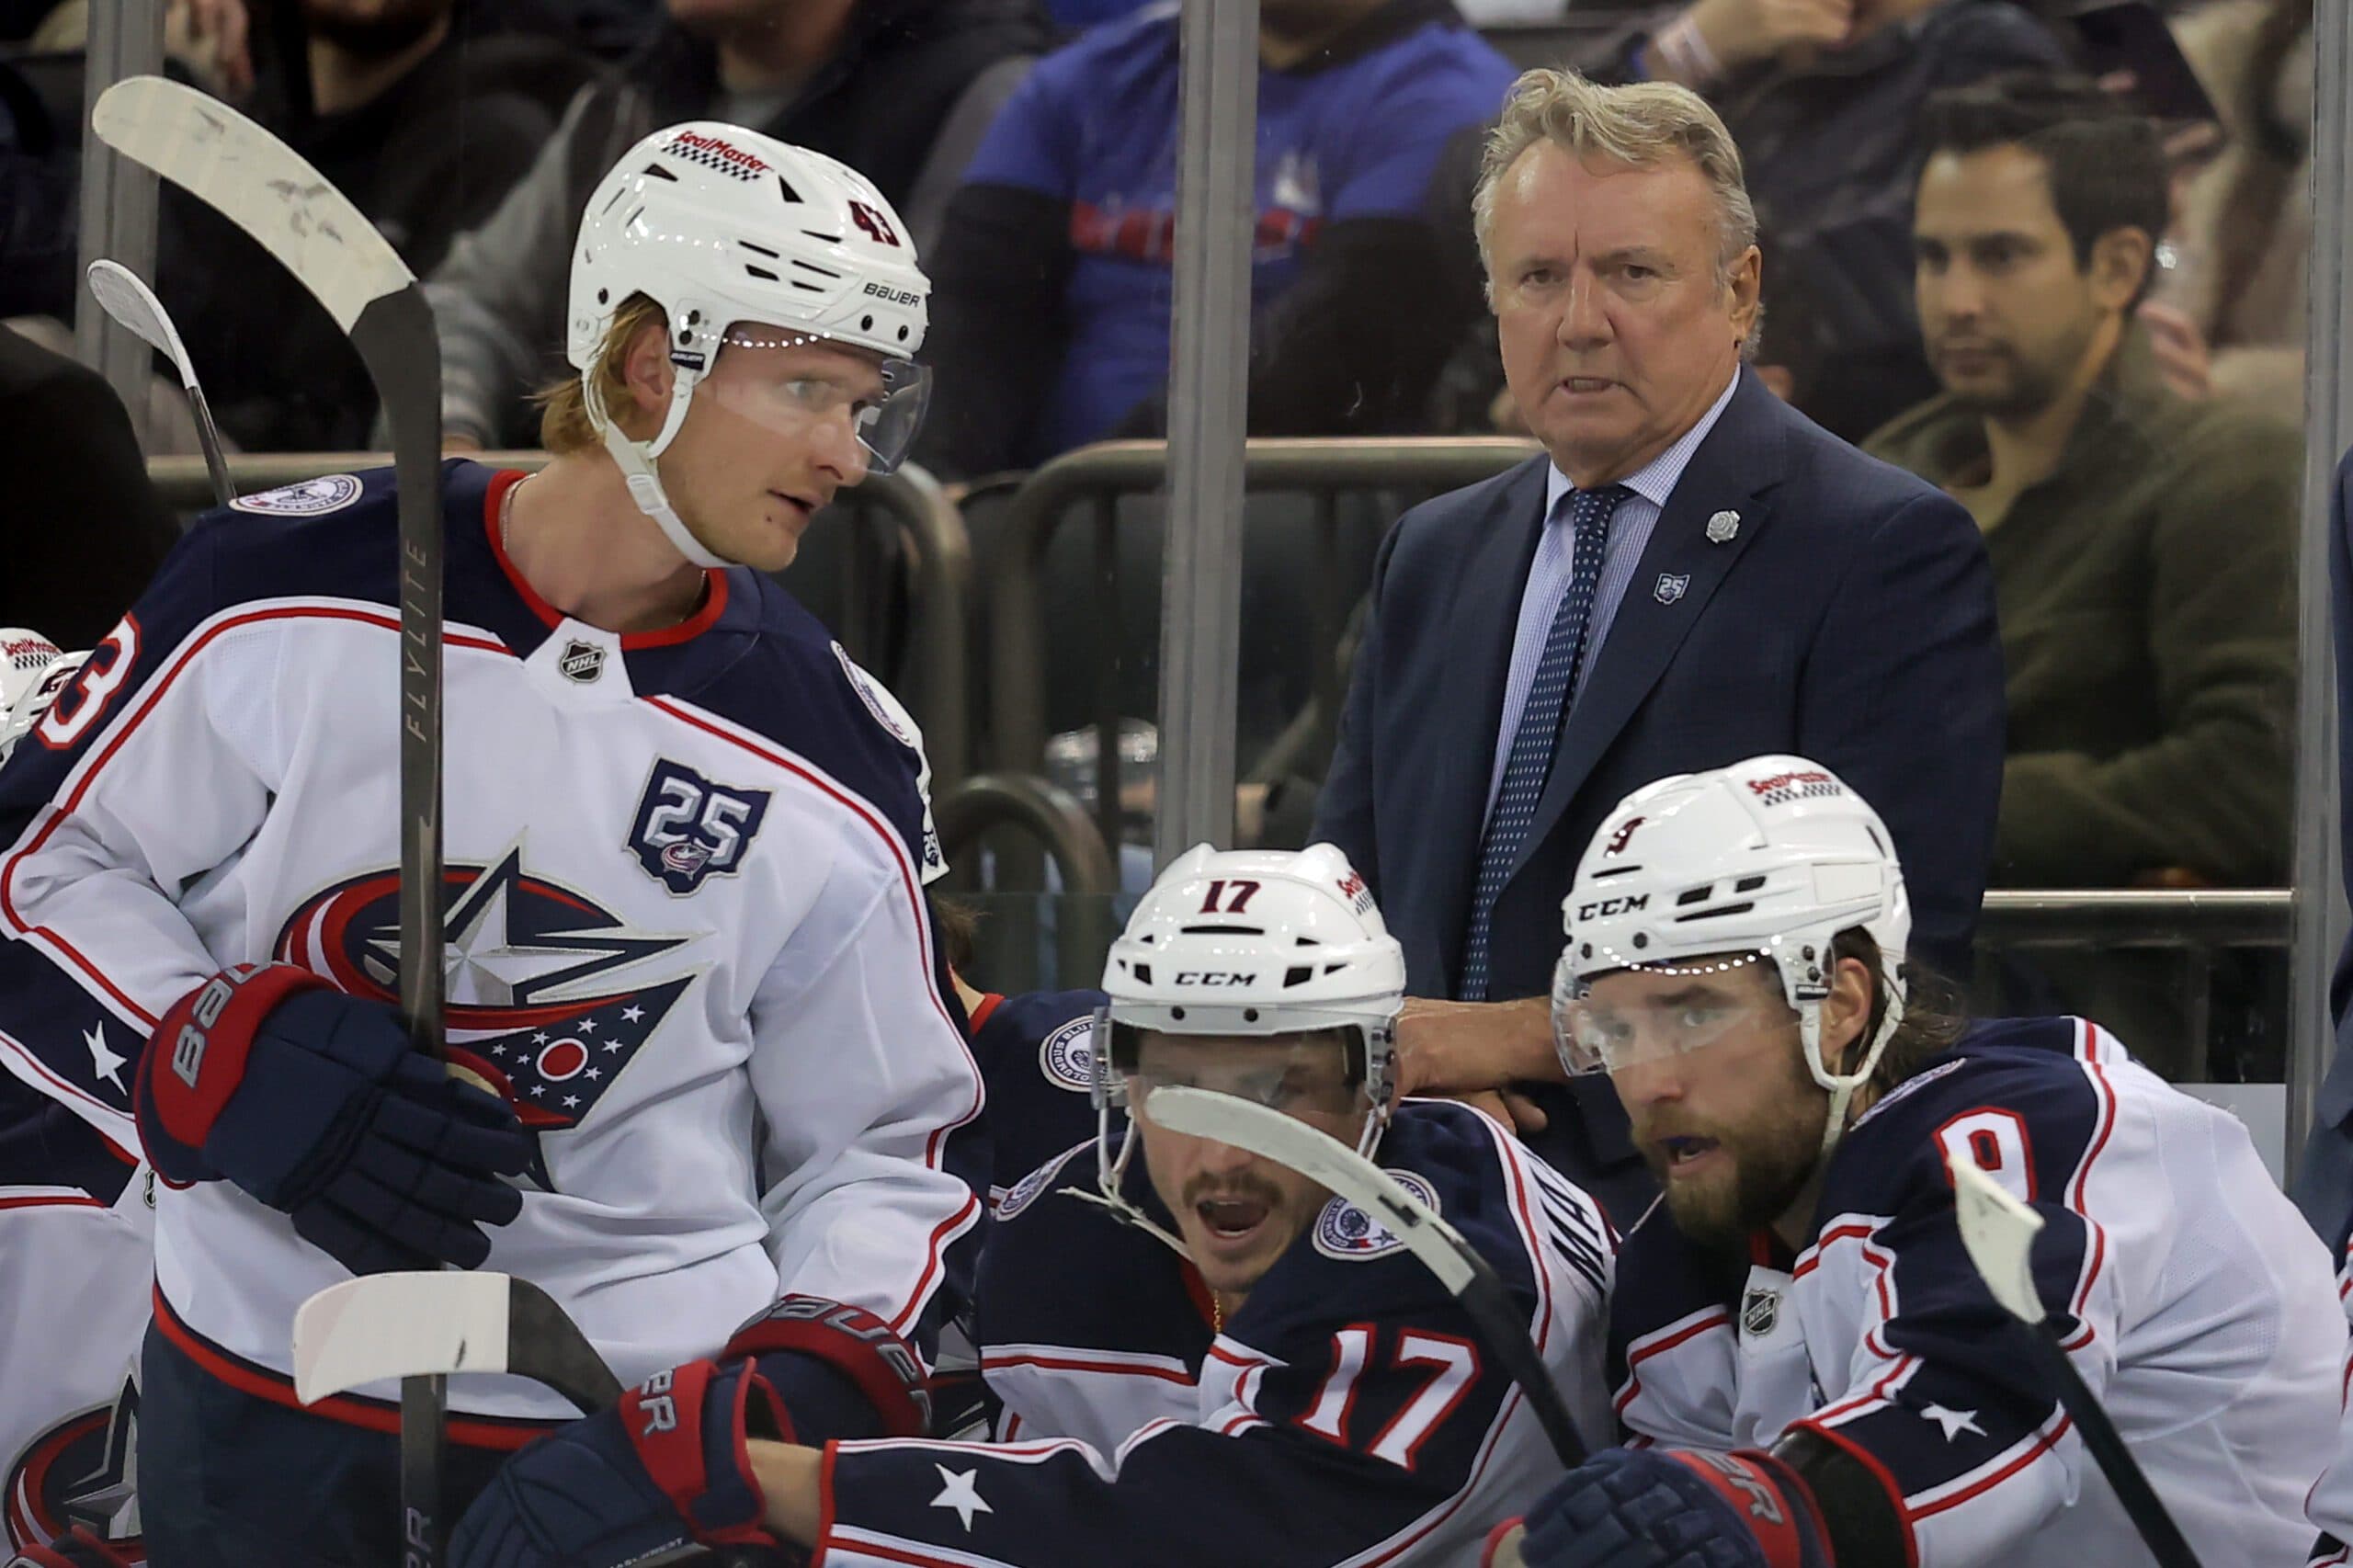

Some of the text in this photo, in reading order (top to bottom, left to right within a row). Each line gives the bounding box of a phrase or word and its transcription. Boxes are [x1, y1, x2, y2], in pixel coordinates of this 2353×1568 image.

[672, 131, 775, 172] SealMaster
[863, 282, 921, 308] BAUER
[1659, 577, 1685, 596] 25
[405, 539, 427, 743] FLYLITE
[566, 654, 599, 673] NHL
[643, 775, 752, 867] 25
[1198, 880, 1262, 915] 17
[1578, 892, 1651, 922] CCM
[1174, 971, 1258, 987] CCM
[1051, 1040, 1091, 1083] OLUMBUS
[1292, 1322, 1483, 1472] 17
